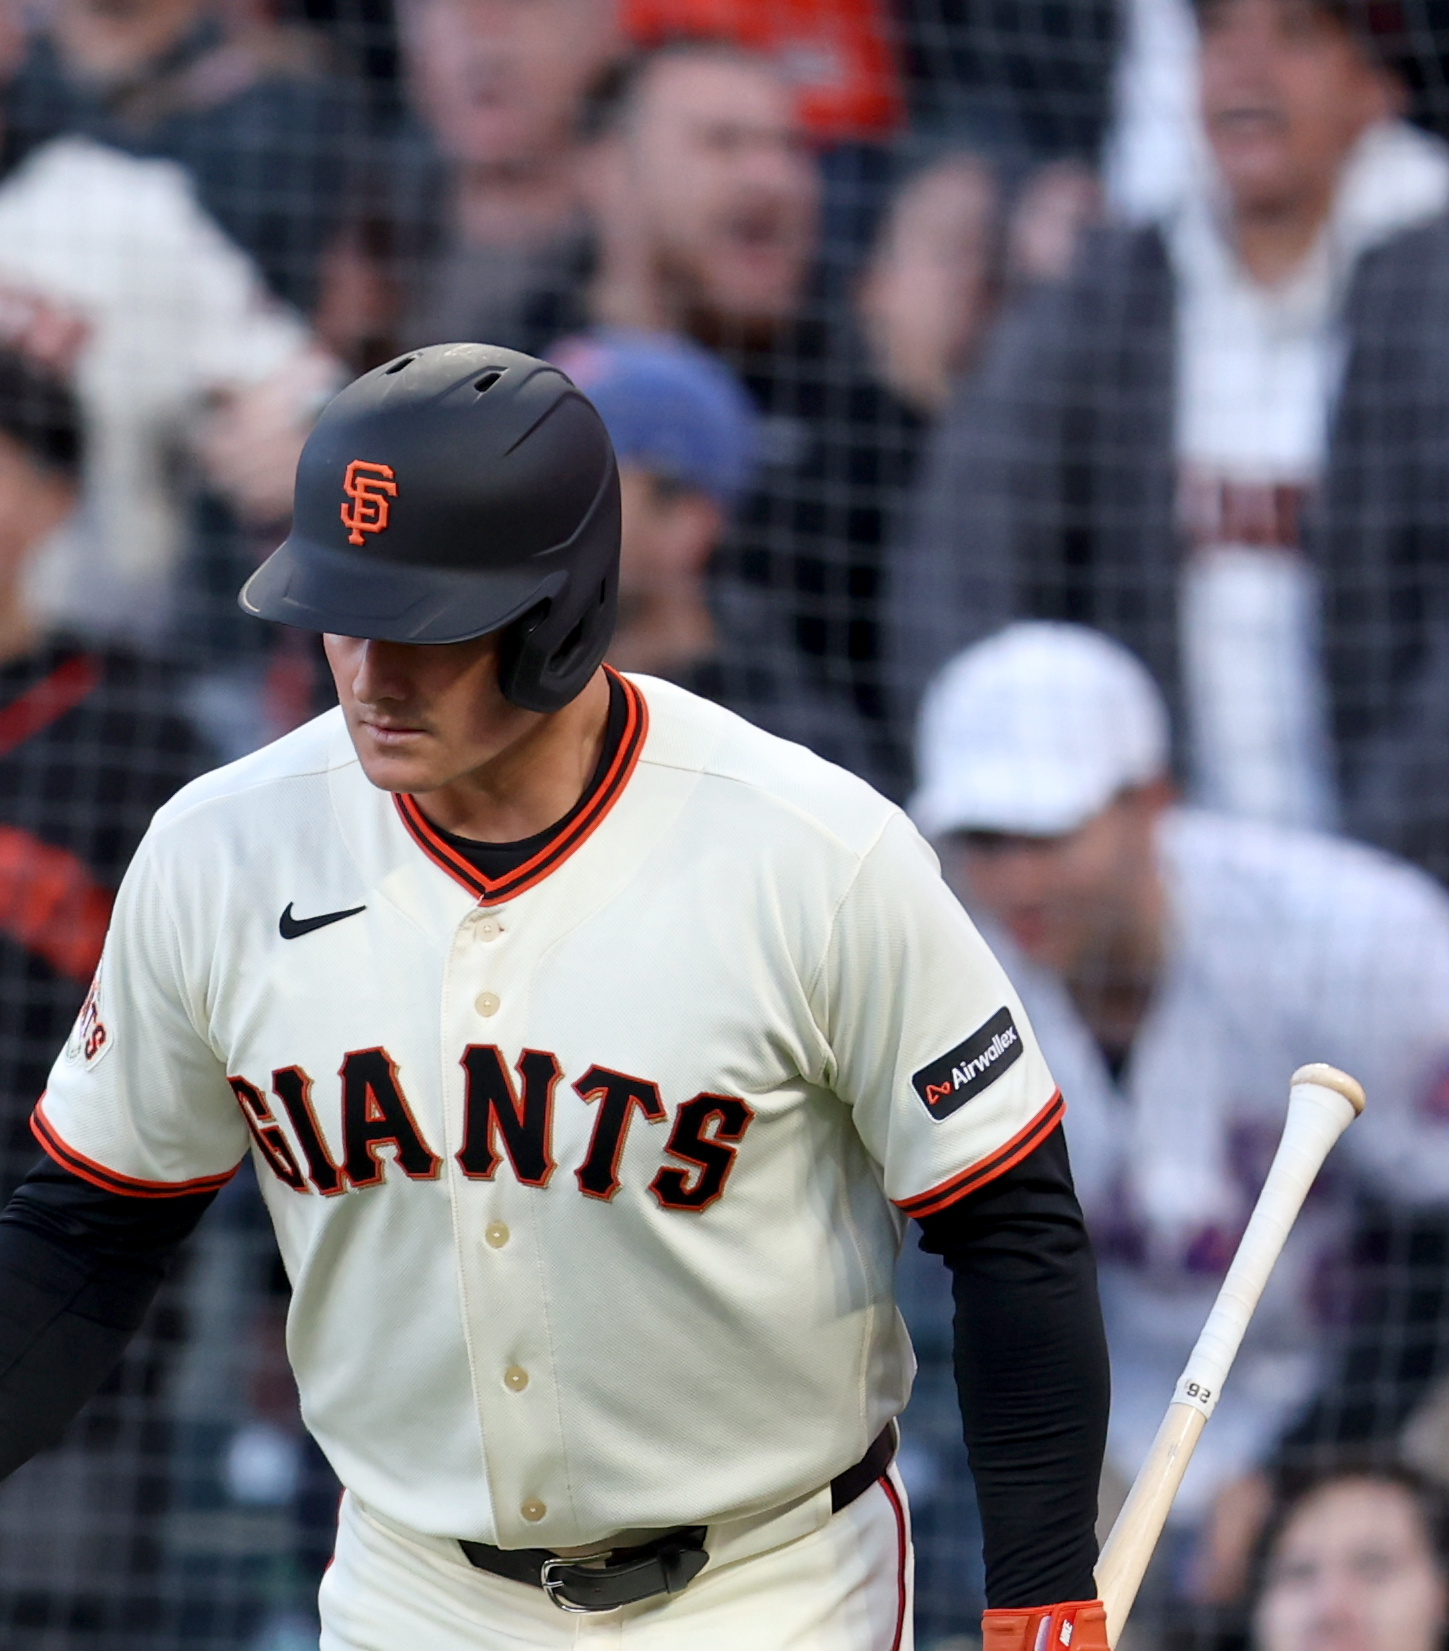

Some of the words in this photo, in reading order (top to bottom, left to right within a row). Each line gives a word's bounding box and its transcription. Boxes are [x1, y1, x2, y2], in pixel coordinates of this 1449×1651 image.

[339, 459, 399, 546] SF
[951, 1025, 1018, 1091] Airwallex
[225, 1043, 755, 1213] GIANTS
[1185, 1381, 1212, 1404] 26
[1059, 1618, 1074, 1648] NIKE
